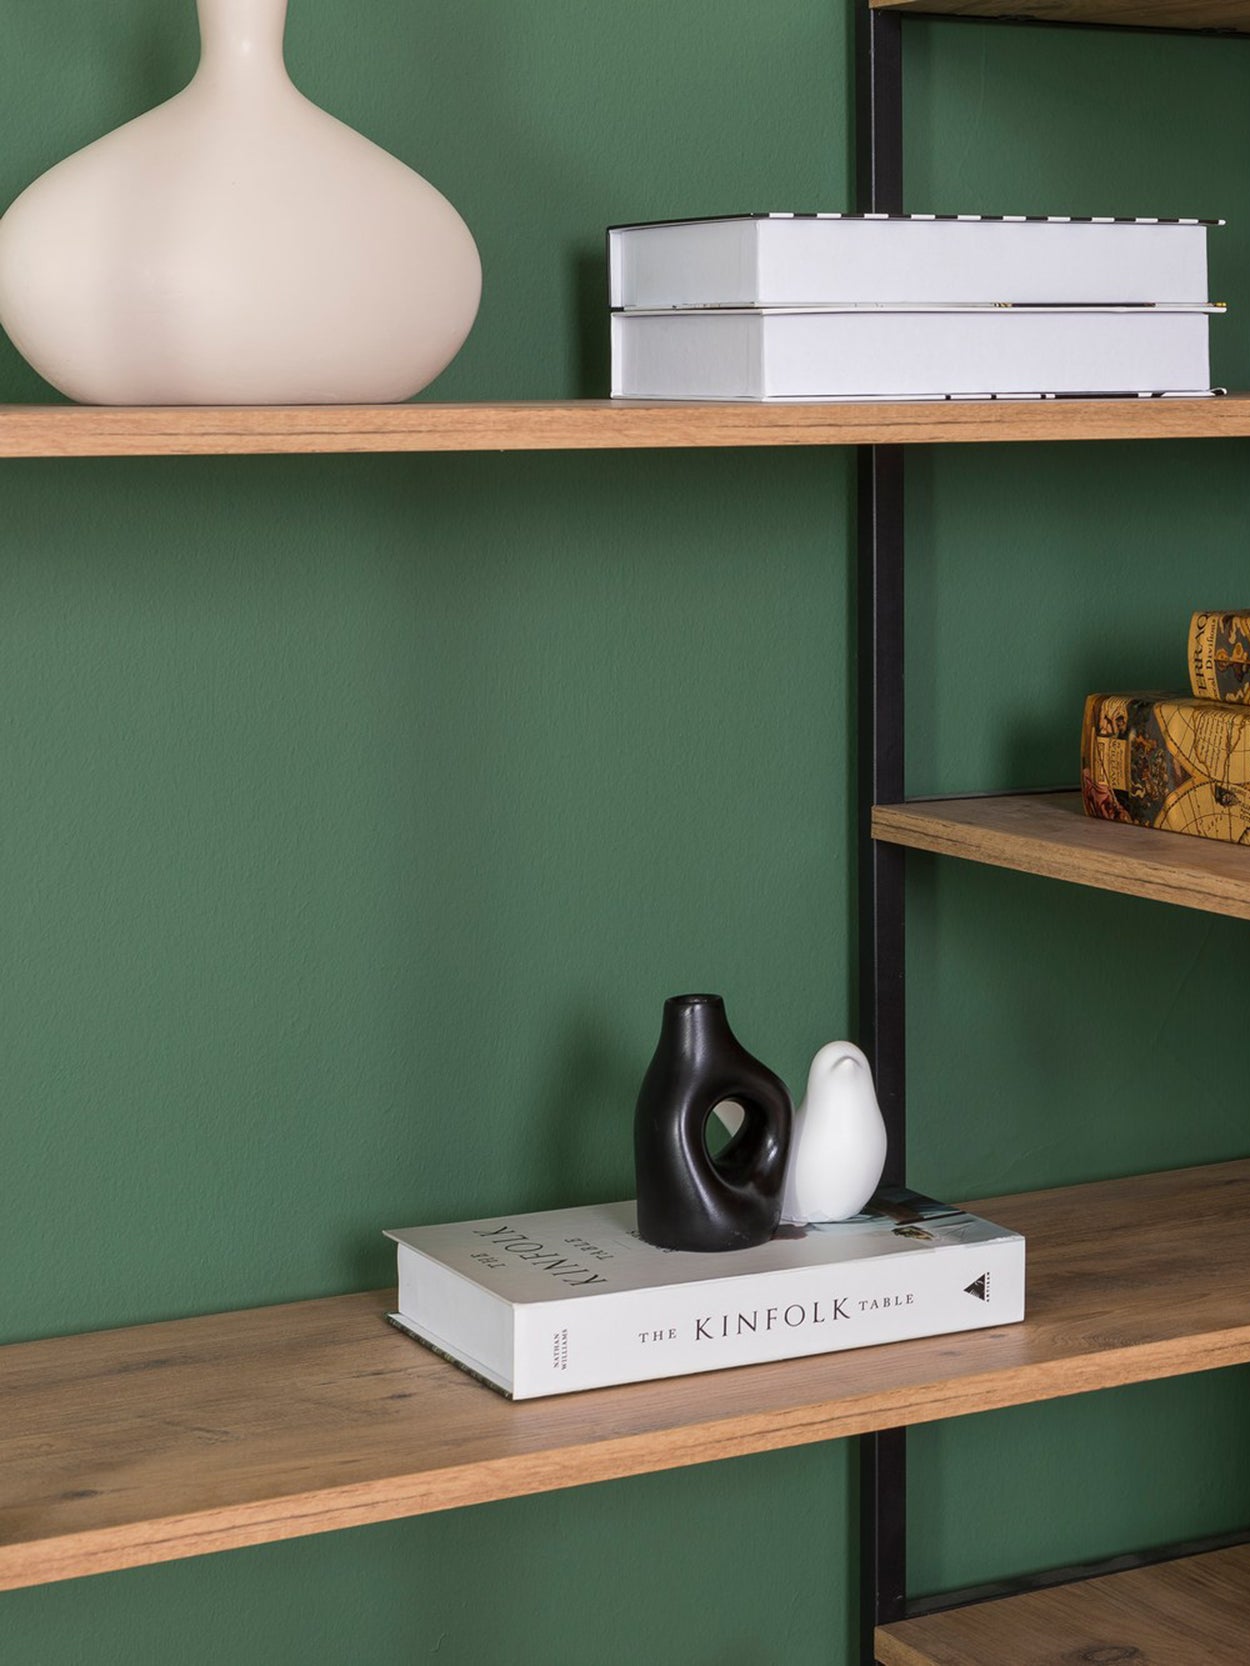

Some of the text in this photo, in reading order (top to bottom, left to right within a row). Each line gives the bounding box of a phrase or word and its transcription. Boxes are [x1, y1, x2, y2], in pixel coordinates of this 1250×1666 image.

[470, 1252, 506, 1269] THE
[474, 1226, 607, 1287] KINFOLK
[564, 1237, 614, 1261] TABLE
[638, 1293, 915, 1343] THE KINFOLK TABLE
